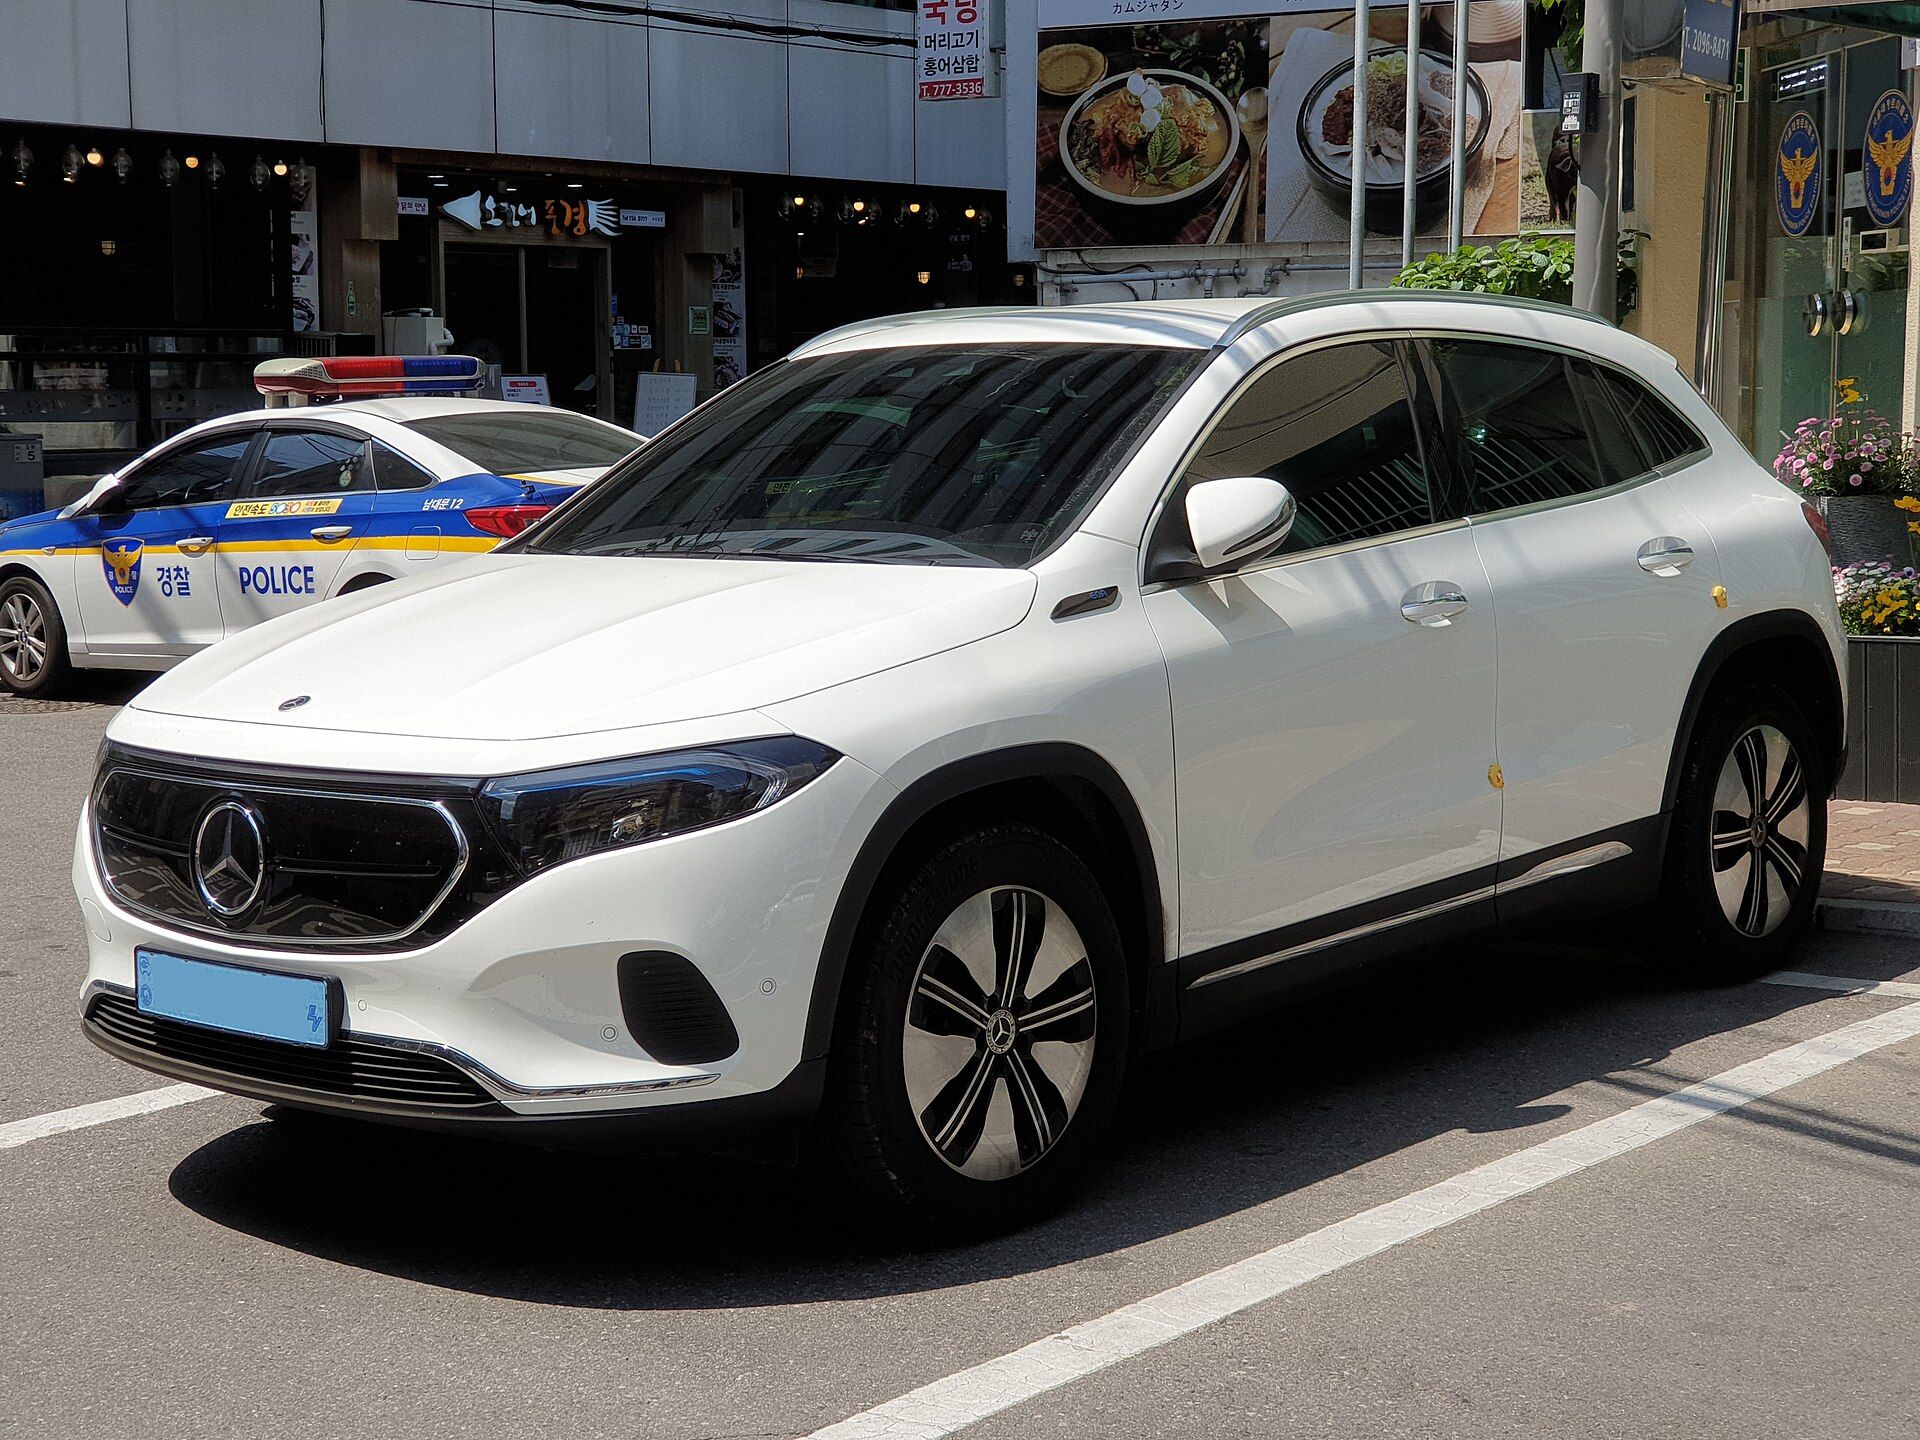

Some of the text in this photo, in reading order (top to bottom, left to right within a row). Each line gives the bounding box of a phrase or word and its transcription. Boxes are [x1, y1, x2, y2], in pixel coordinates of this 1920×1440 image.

[1112, 0, 1184, 15] カムジャタン
[924, 29, 979, 52] 머리고기
[1692, 28, 1730, 61] 2096-8471
[923, 53, 980, 77] 홍어삼합
[921, 82, 982, 97] T. 777-3536
[27, 451, 35, 461] 5
[233, 502, 302, 517] 안전속도 5030
[422, 498, 464, 511] 남대문 12
[157, 565, 192, 597] 경찰
[239, 566, 315, 594] POLICE
[115, 586, 134, 594] POLICE
[307, 1004, 322, 1032] EV
